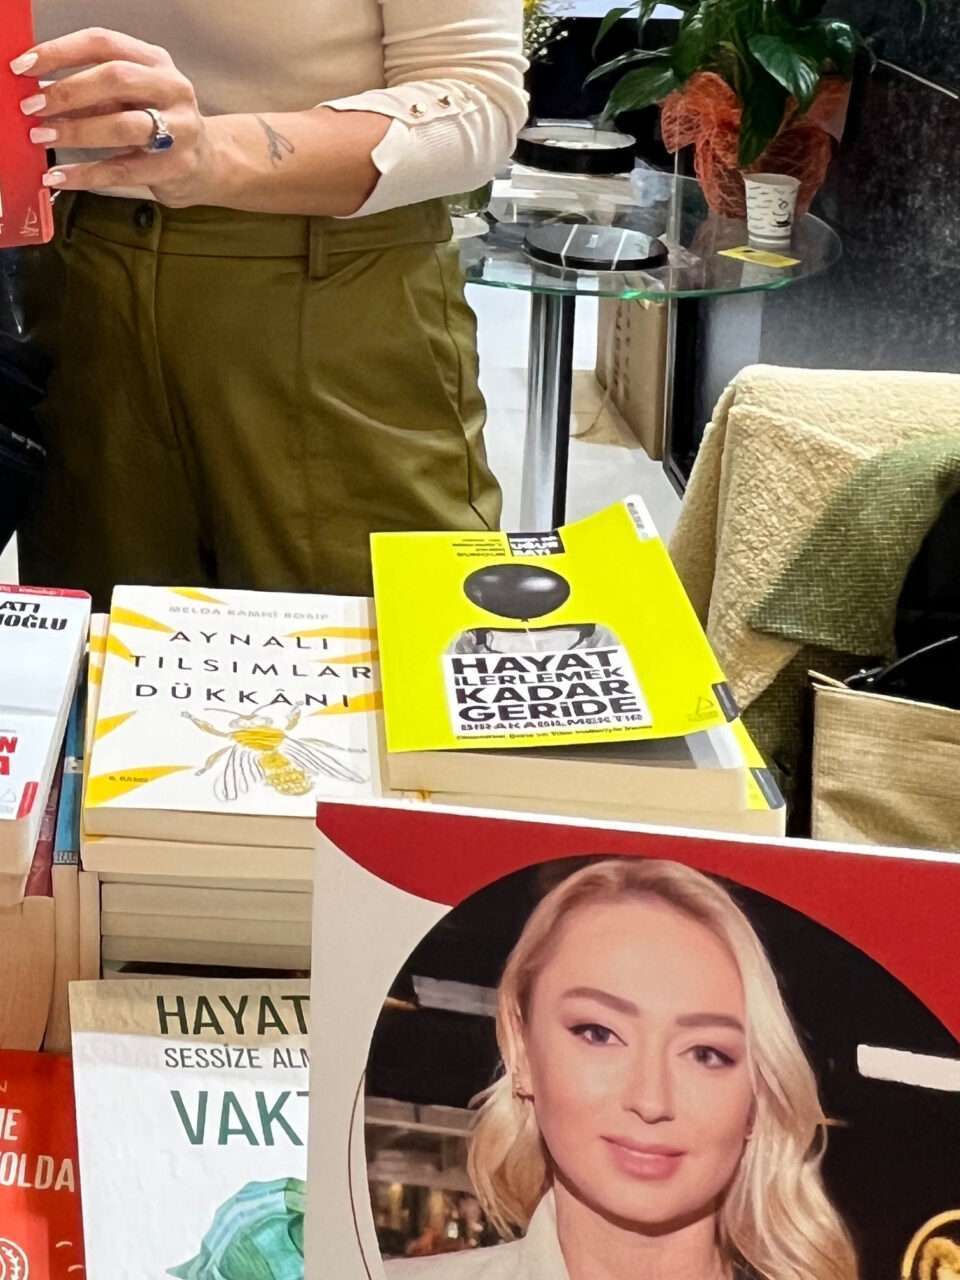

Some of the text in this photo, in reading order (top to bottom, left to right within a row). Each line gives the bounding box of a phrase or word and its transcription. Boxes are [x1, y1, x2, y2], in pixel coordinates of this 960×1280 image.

[170, 631, 328, 651] AYNALI
[130, 655, 372, 679] TILSIMLAR
[451, 650, 618, 675] HAYAT
[455, 667, 625, 687] İLERLEMEK
[136, 682, 349, 708] DÜKKÂNI
[456, 680, 633, 704] KADAR
[459, 697, 641, 723] GERİDE
[156, 995, 310, 1035] HAYAT
[164, 1043, 263, 1069] SESSİZE
[170, 1090, 310, 1146] VAK
